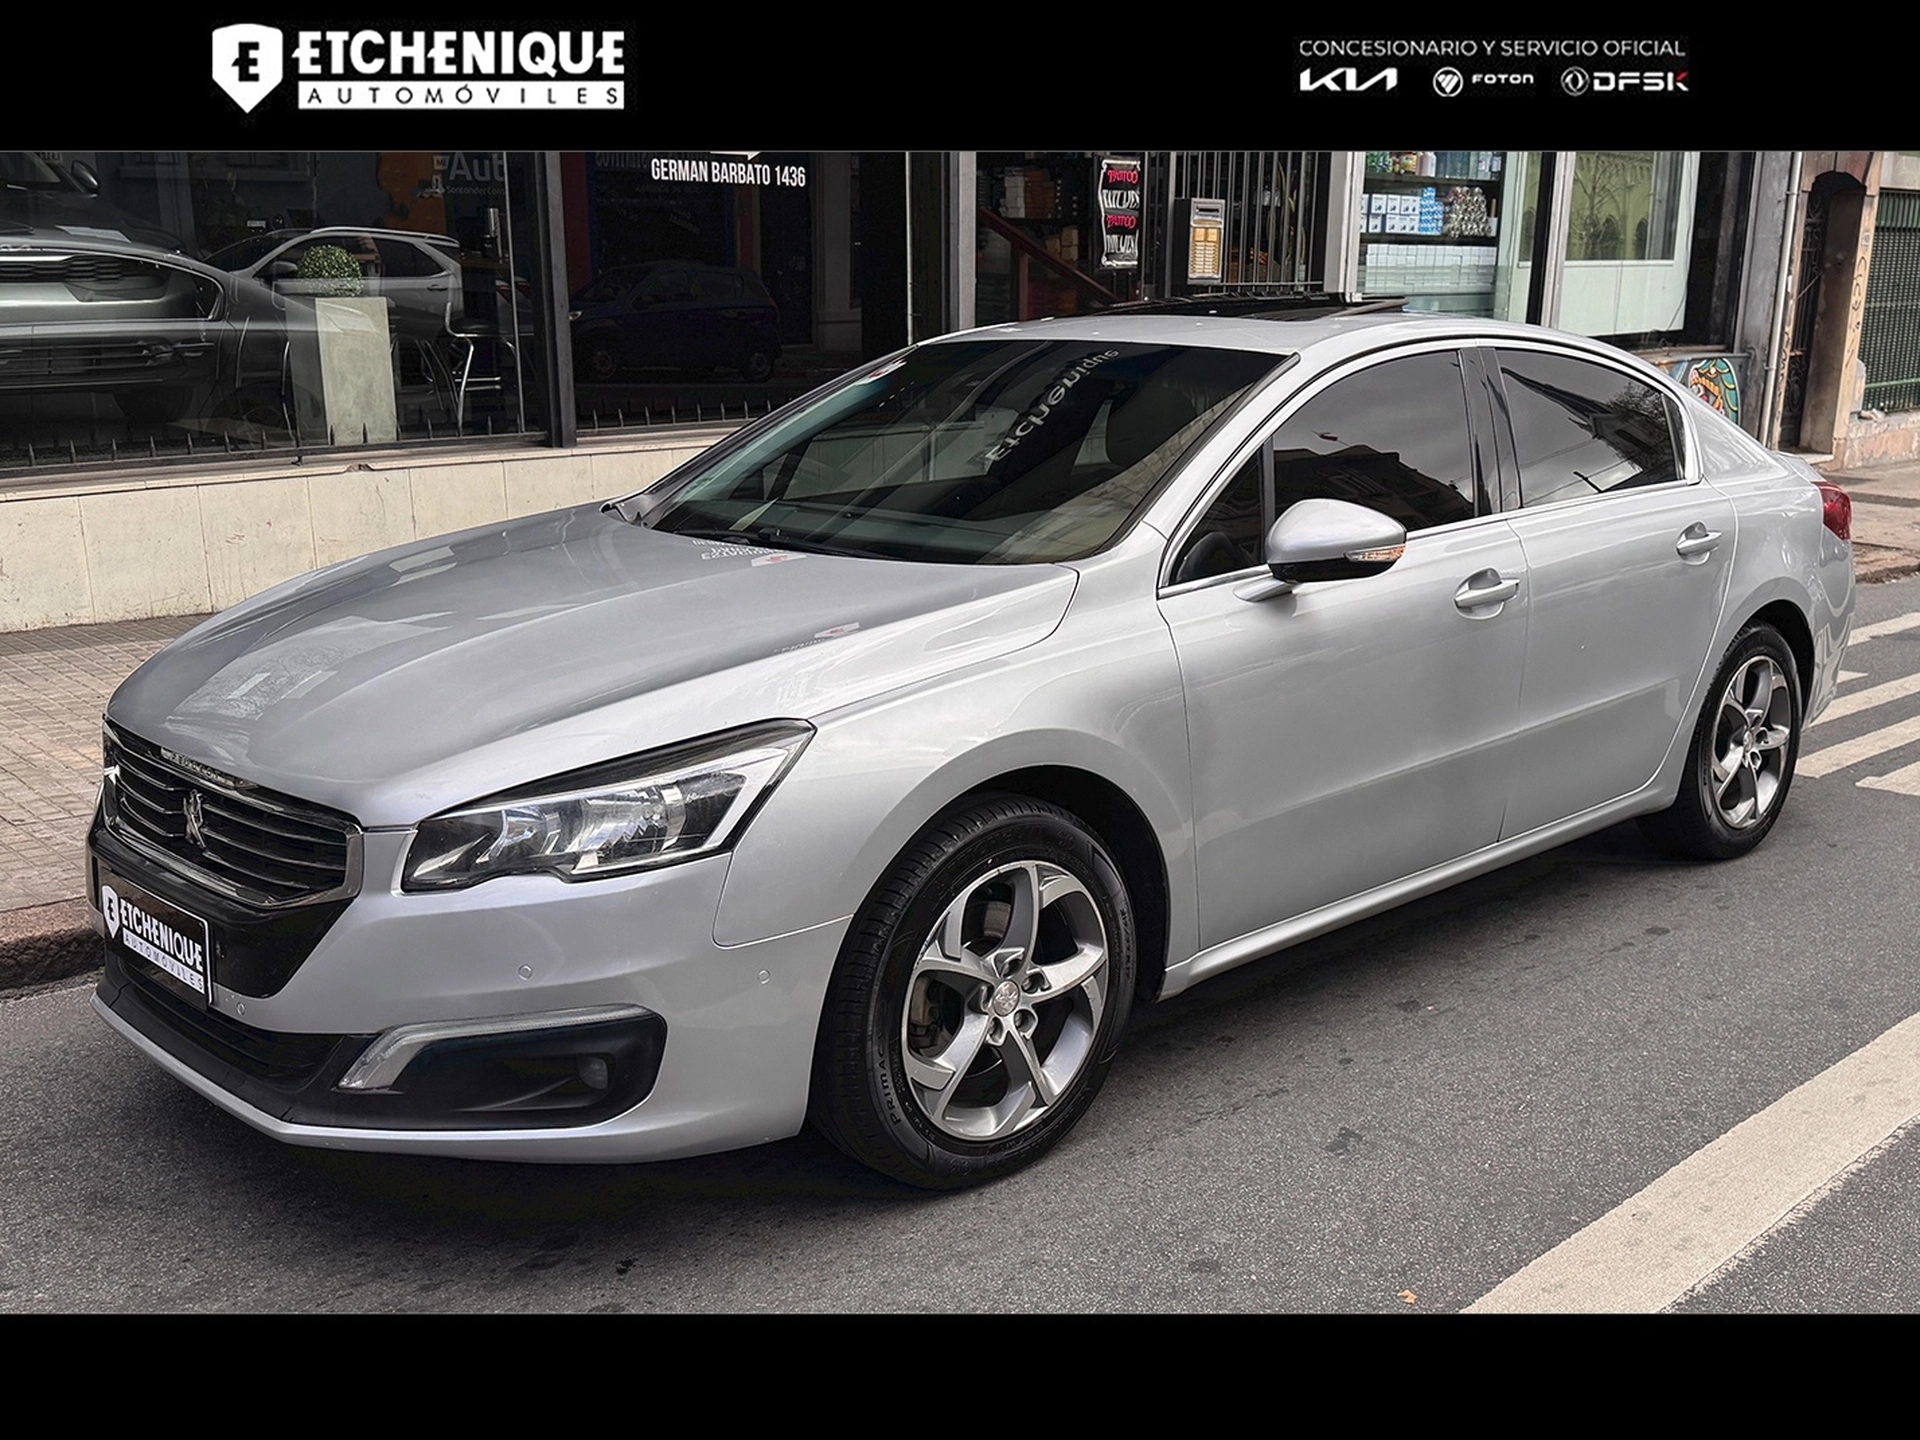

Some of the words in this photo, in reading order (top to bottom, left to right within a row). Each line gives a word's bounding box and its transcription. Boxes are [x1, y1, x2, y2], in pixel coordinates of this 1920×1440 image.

[650, 158, 709, 184] GERMAN
[711, 161, 771, 186] BARBATO
[774, 166, 806, 188] 1436
[119, 898, 205, 973] ETCHENIQUE
